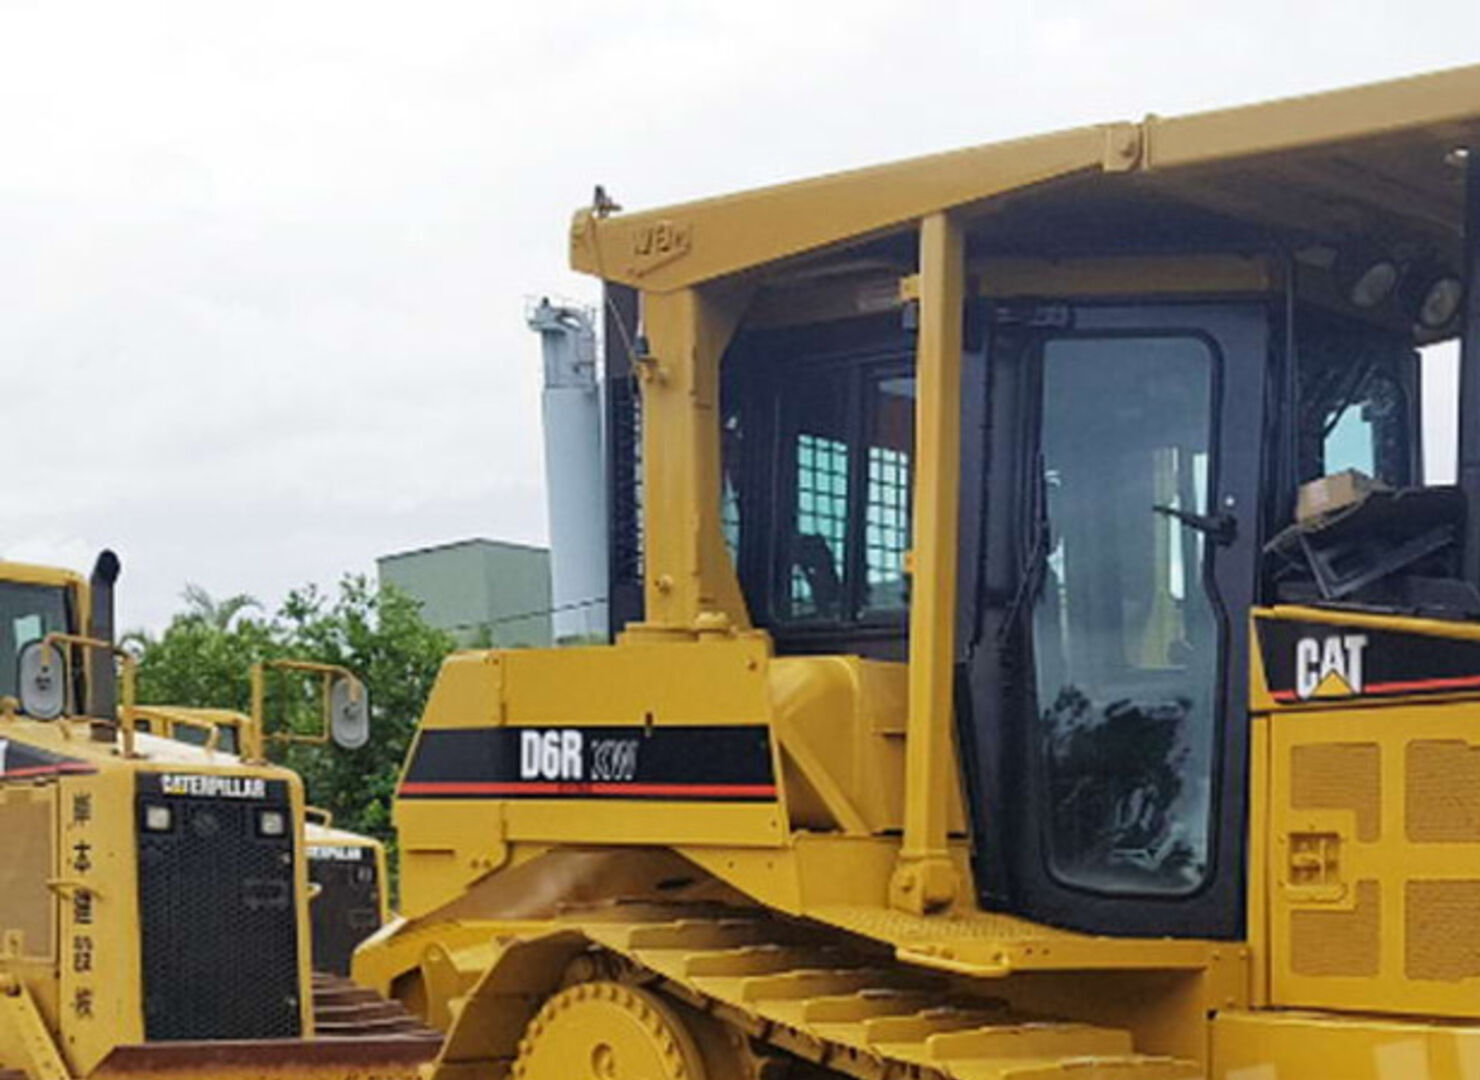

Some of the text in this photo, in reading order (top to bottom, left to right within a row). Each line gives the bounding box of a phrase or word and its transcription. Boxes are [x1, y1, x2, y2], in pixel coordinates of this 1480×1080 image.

[1296, 634, 1368, 699] CAT
[520, 729, 584, 780] D6R
[161, 774, 267, 798] CATERPILLAR
